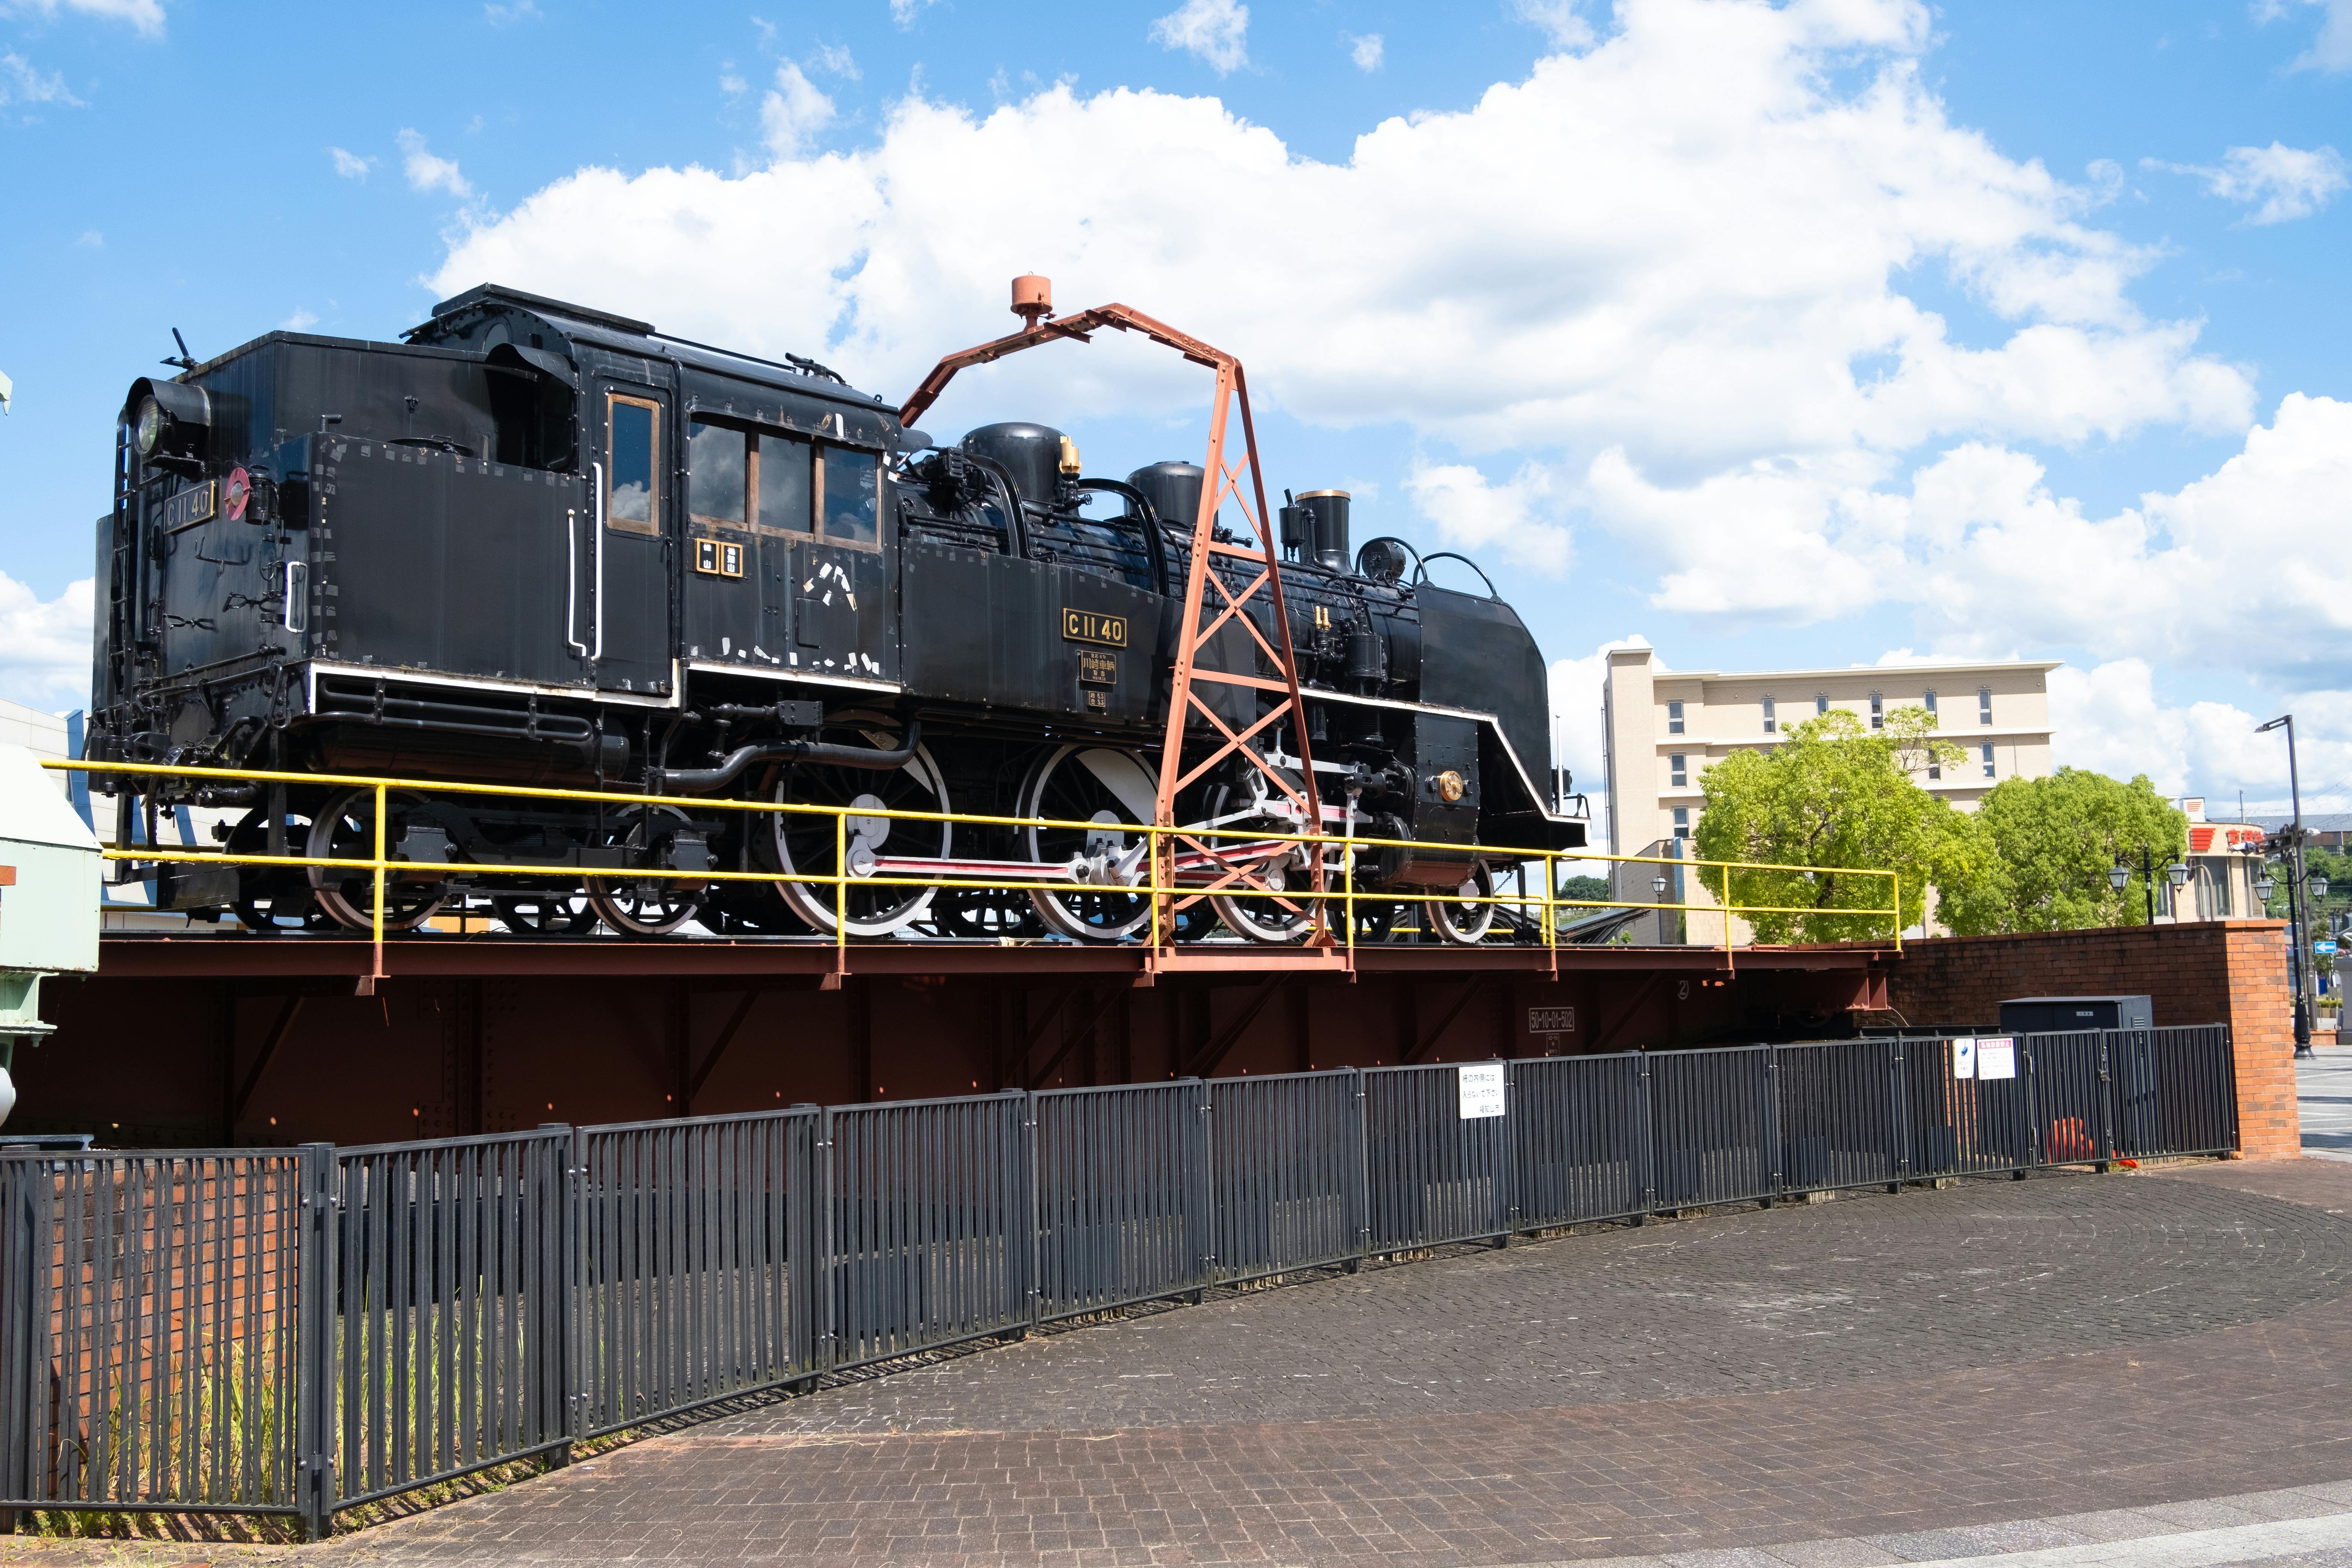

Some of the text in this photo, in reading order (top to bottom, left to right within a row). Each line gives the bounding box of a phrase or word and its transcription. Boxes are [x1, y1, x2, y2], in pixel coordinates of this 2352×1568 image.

[168, 489, 208, 526] C11 40
[1069, 614, 1122, 641] C11 40
[1531, 1011, 1573, 1029] 50-10-01-502
[1463, 1089, 1500, 1099] 入らないで下さい
[1480, 1105, 1500, 1113] 福知山市
